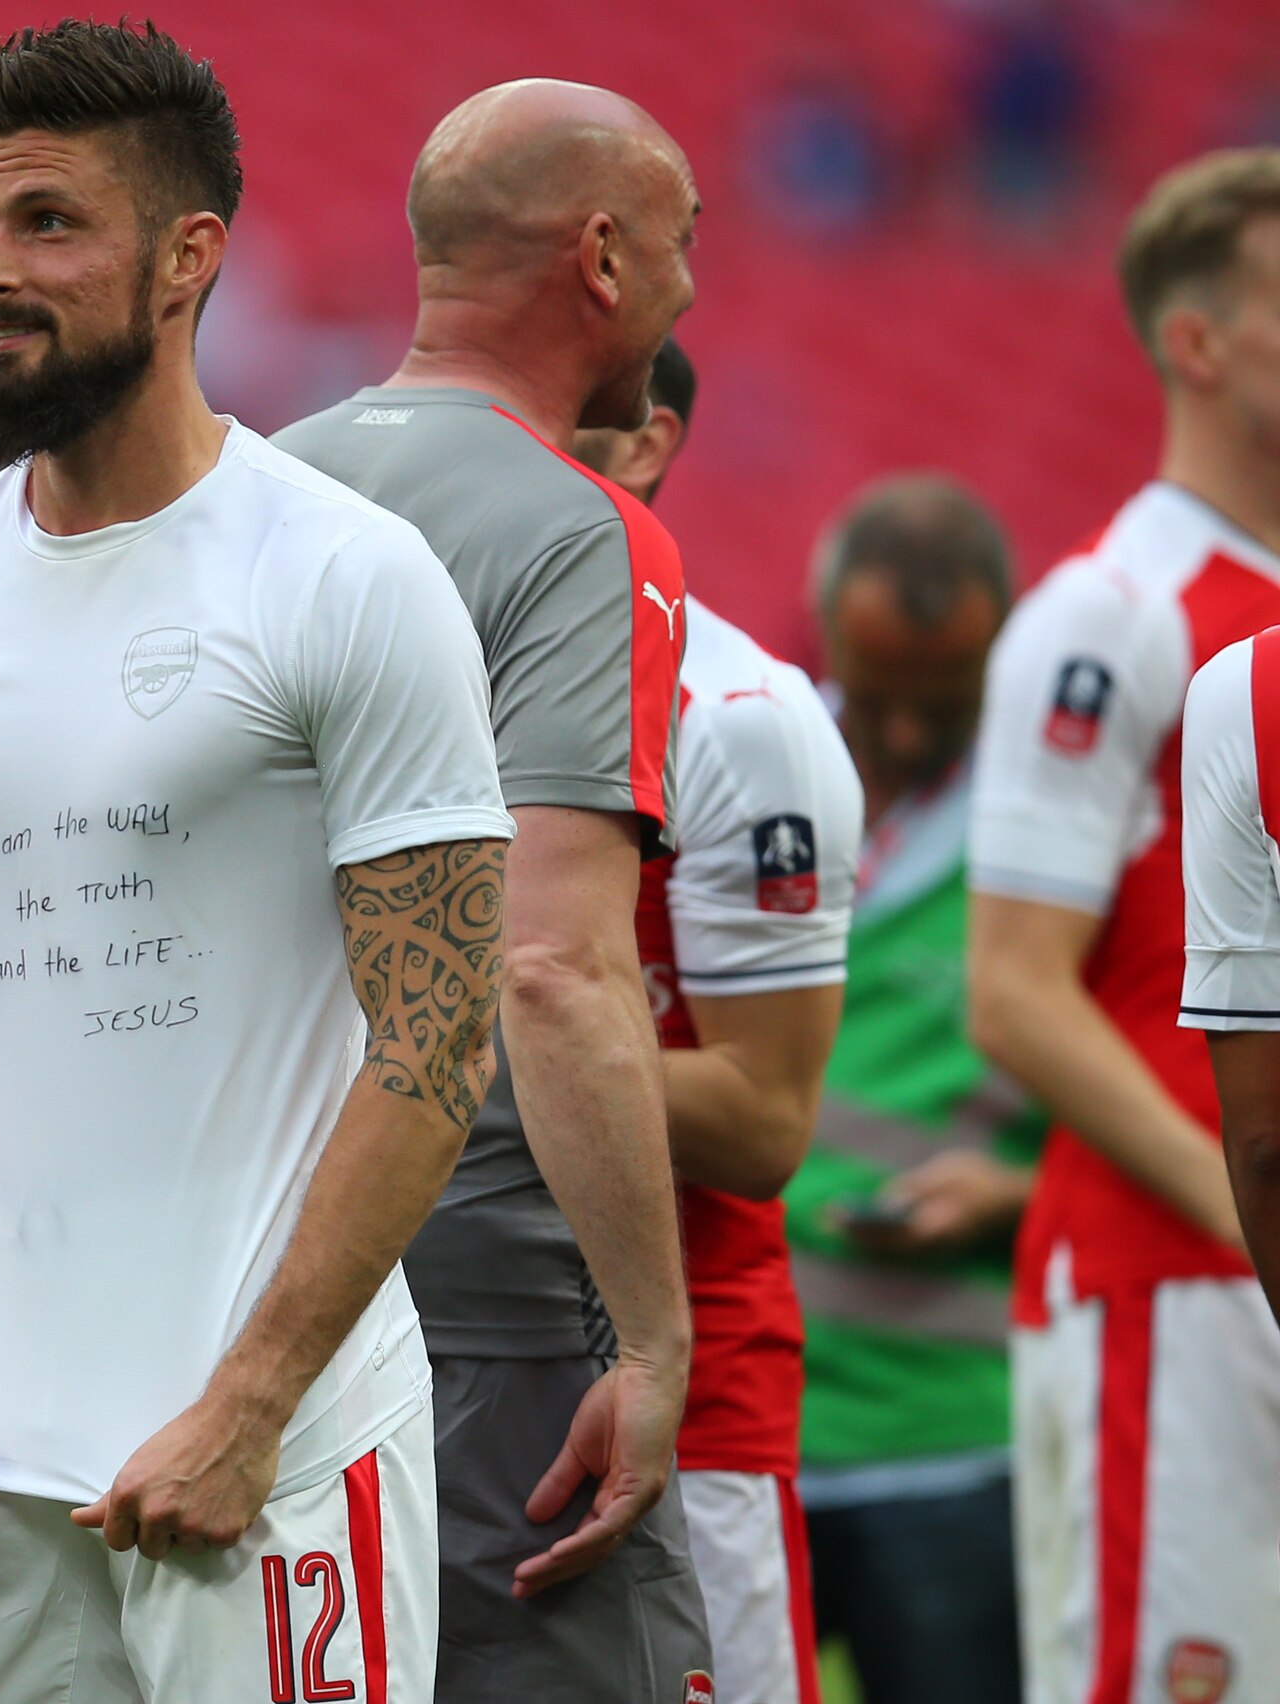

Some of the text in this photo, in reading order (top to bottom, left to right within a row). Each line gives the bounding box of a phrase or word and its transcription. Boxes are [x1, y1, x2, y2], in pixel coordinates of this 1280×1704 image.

[352, 408, 414, 425] ARSENAL
[1, 828, 32, 854] am
[54, 806, 88, 840] the
[16, 888, 56, 922] the
[44, 946, 82, 977] the
[84, 996, 199, 1037] JESUS
[261, 1551, 355, 1704] 12
